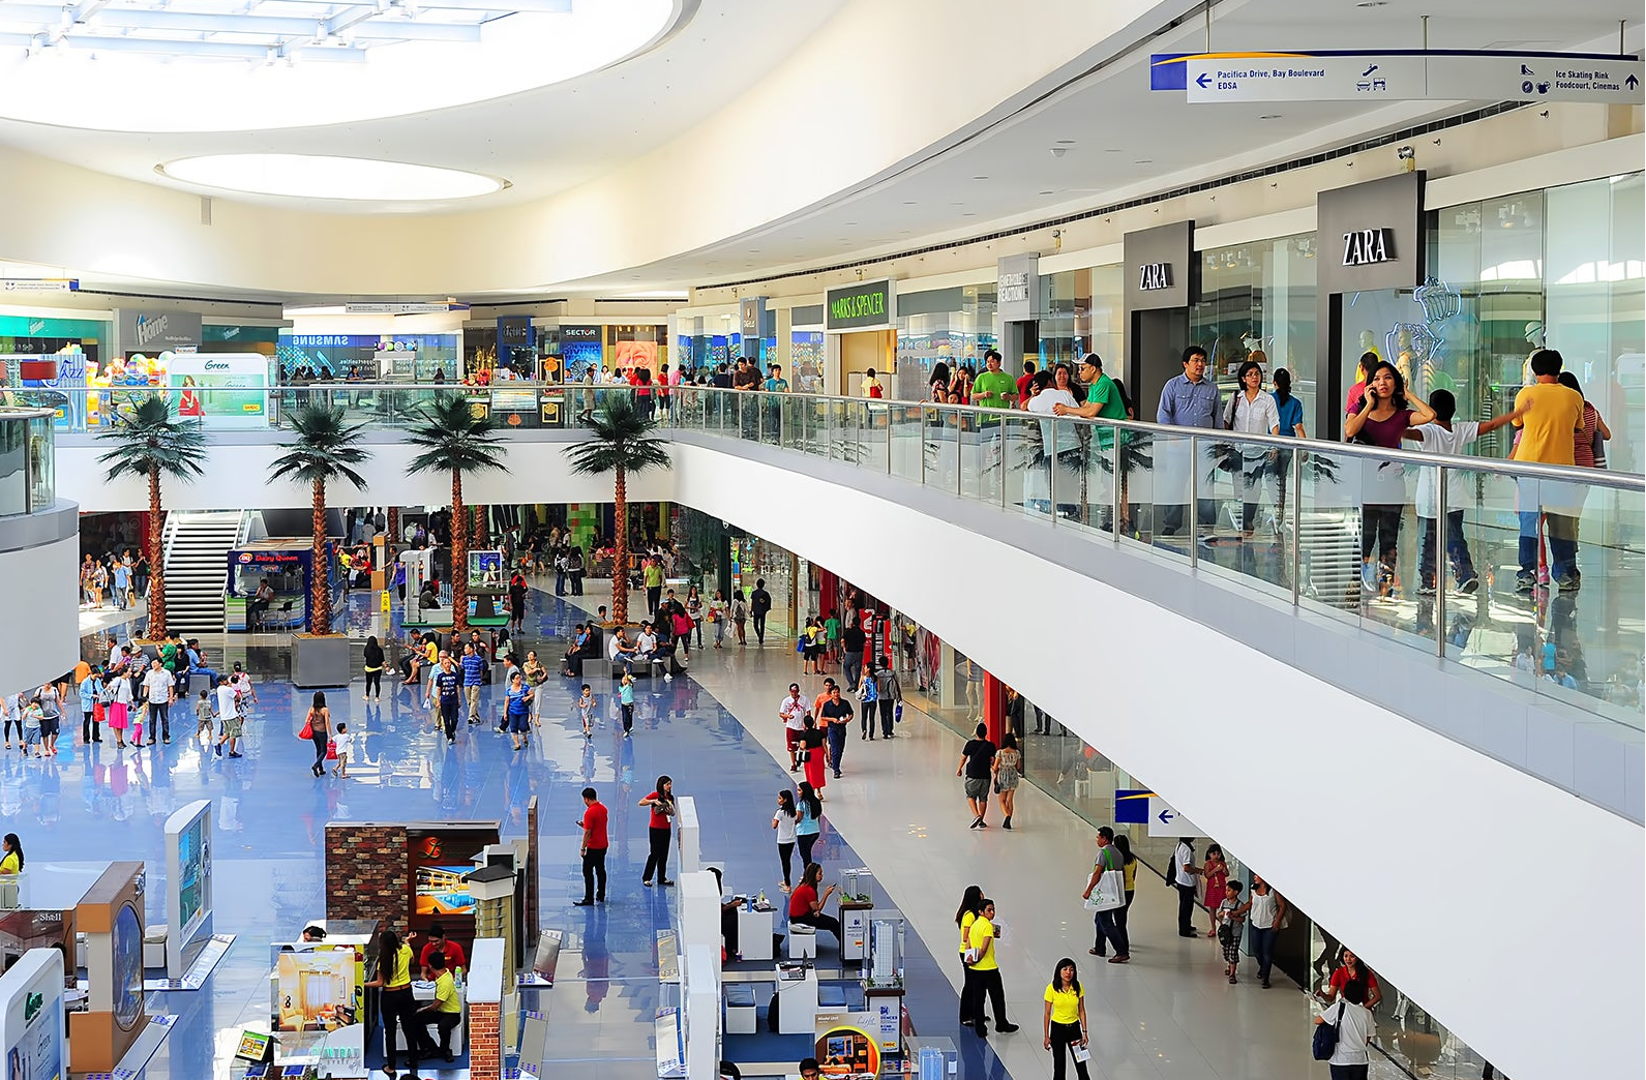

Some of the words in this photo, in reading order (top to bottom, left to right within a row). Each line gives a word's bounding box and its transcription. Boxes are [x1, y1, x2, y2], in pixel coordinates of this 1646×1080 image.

[1217, 70, 1248, 79] Pacifica
[1249, 69, 1271, 79] Drive,
[1272, 69, 1286, 79] Bay
[1288, 69, 1325, 78] Boulevard
[1555, 70, 1566, 79] Ice
[1568, 70, 1593, 80] Skating
[1594, 71, 1609, 79] Rink
[1217, 82, 1238, 90] EDSA
[1555, 81, 1591, 90] Foodcourt,
[1592, 82, 1620, 91] Cinemas
[1342, 227, 1388, 266] ZARA
[1139, 263, 1168, 291] ZARA
[831, 297, 851, 319] MARKS
[851, 296, 857, 318] &
[856, 292, 885, 318] SPENCER
[204, 359, 230, 370] Green
[255, 555, 275, 563] Dairy
[39, 912, 62, 922] Shell
